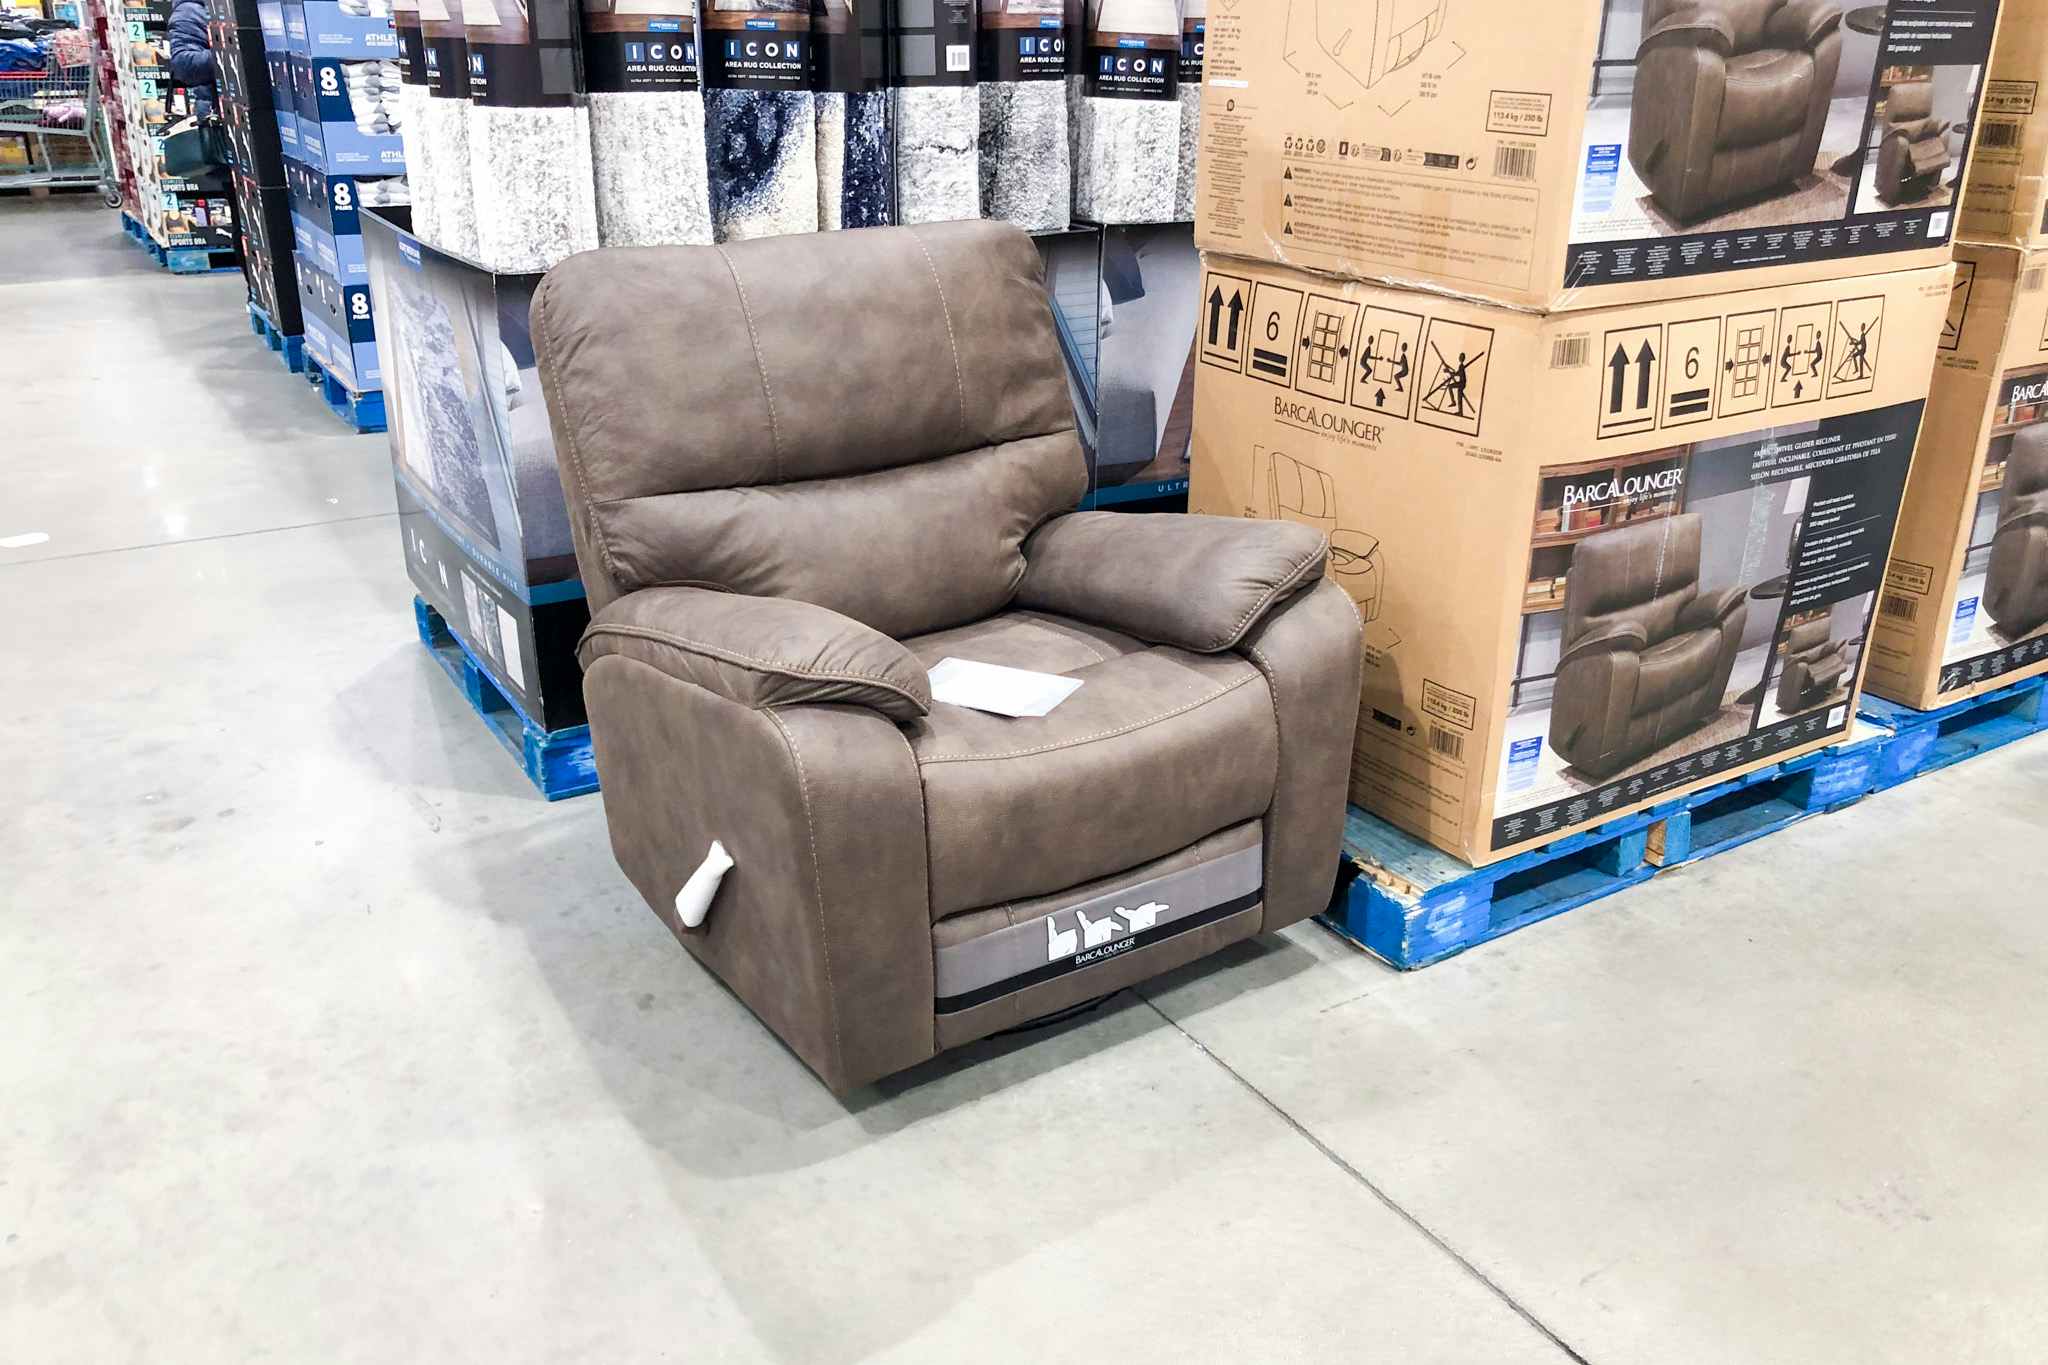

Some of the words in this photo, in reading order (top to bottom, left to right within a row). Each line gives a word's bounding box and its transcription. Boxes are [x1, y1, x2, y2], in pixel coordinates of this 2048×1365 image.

[132, 24, 140, 36] 2
[365, 34, 397, 42] ATHLET
[1025, 38, 1064, 52] ICO
[632, 44, 695, 60] ICON
[730, 42, 798, 57] ICON
[759, 62, 801, 70] COLLECTION
[1020, 56, 1036, 64] AREA
[1104, 58, 1163, 73] ICON
[161, 71, 170, 80] BR
[320, 66, 338, 91] 8
[1127, 76, 1165, 84] COLLECTION
[145, 81, 151, 94] 2
[380, 151, 403, 159] ATHL
[334, 183, 352, 206] 8
[351, 293, 369, 315] 8
[1266, 311, 1281, 341] 6
[1685, 347, 1701, 380] 6
[2012, 380, 2048, 402] BARCA
[1274, 396, 1382, 444] BARCALOUNGER
[1158, 481, 1189, 493] ULTR
[1564, 468, 1683, 506] BARCALOUNGER
[411, 527, 449, 590] ICN
[1075, 936, 1135, 965] BARCALOUNGER
